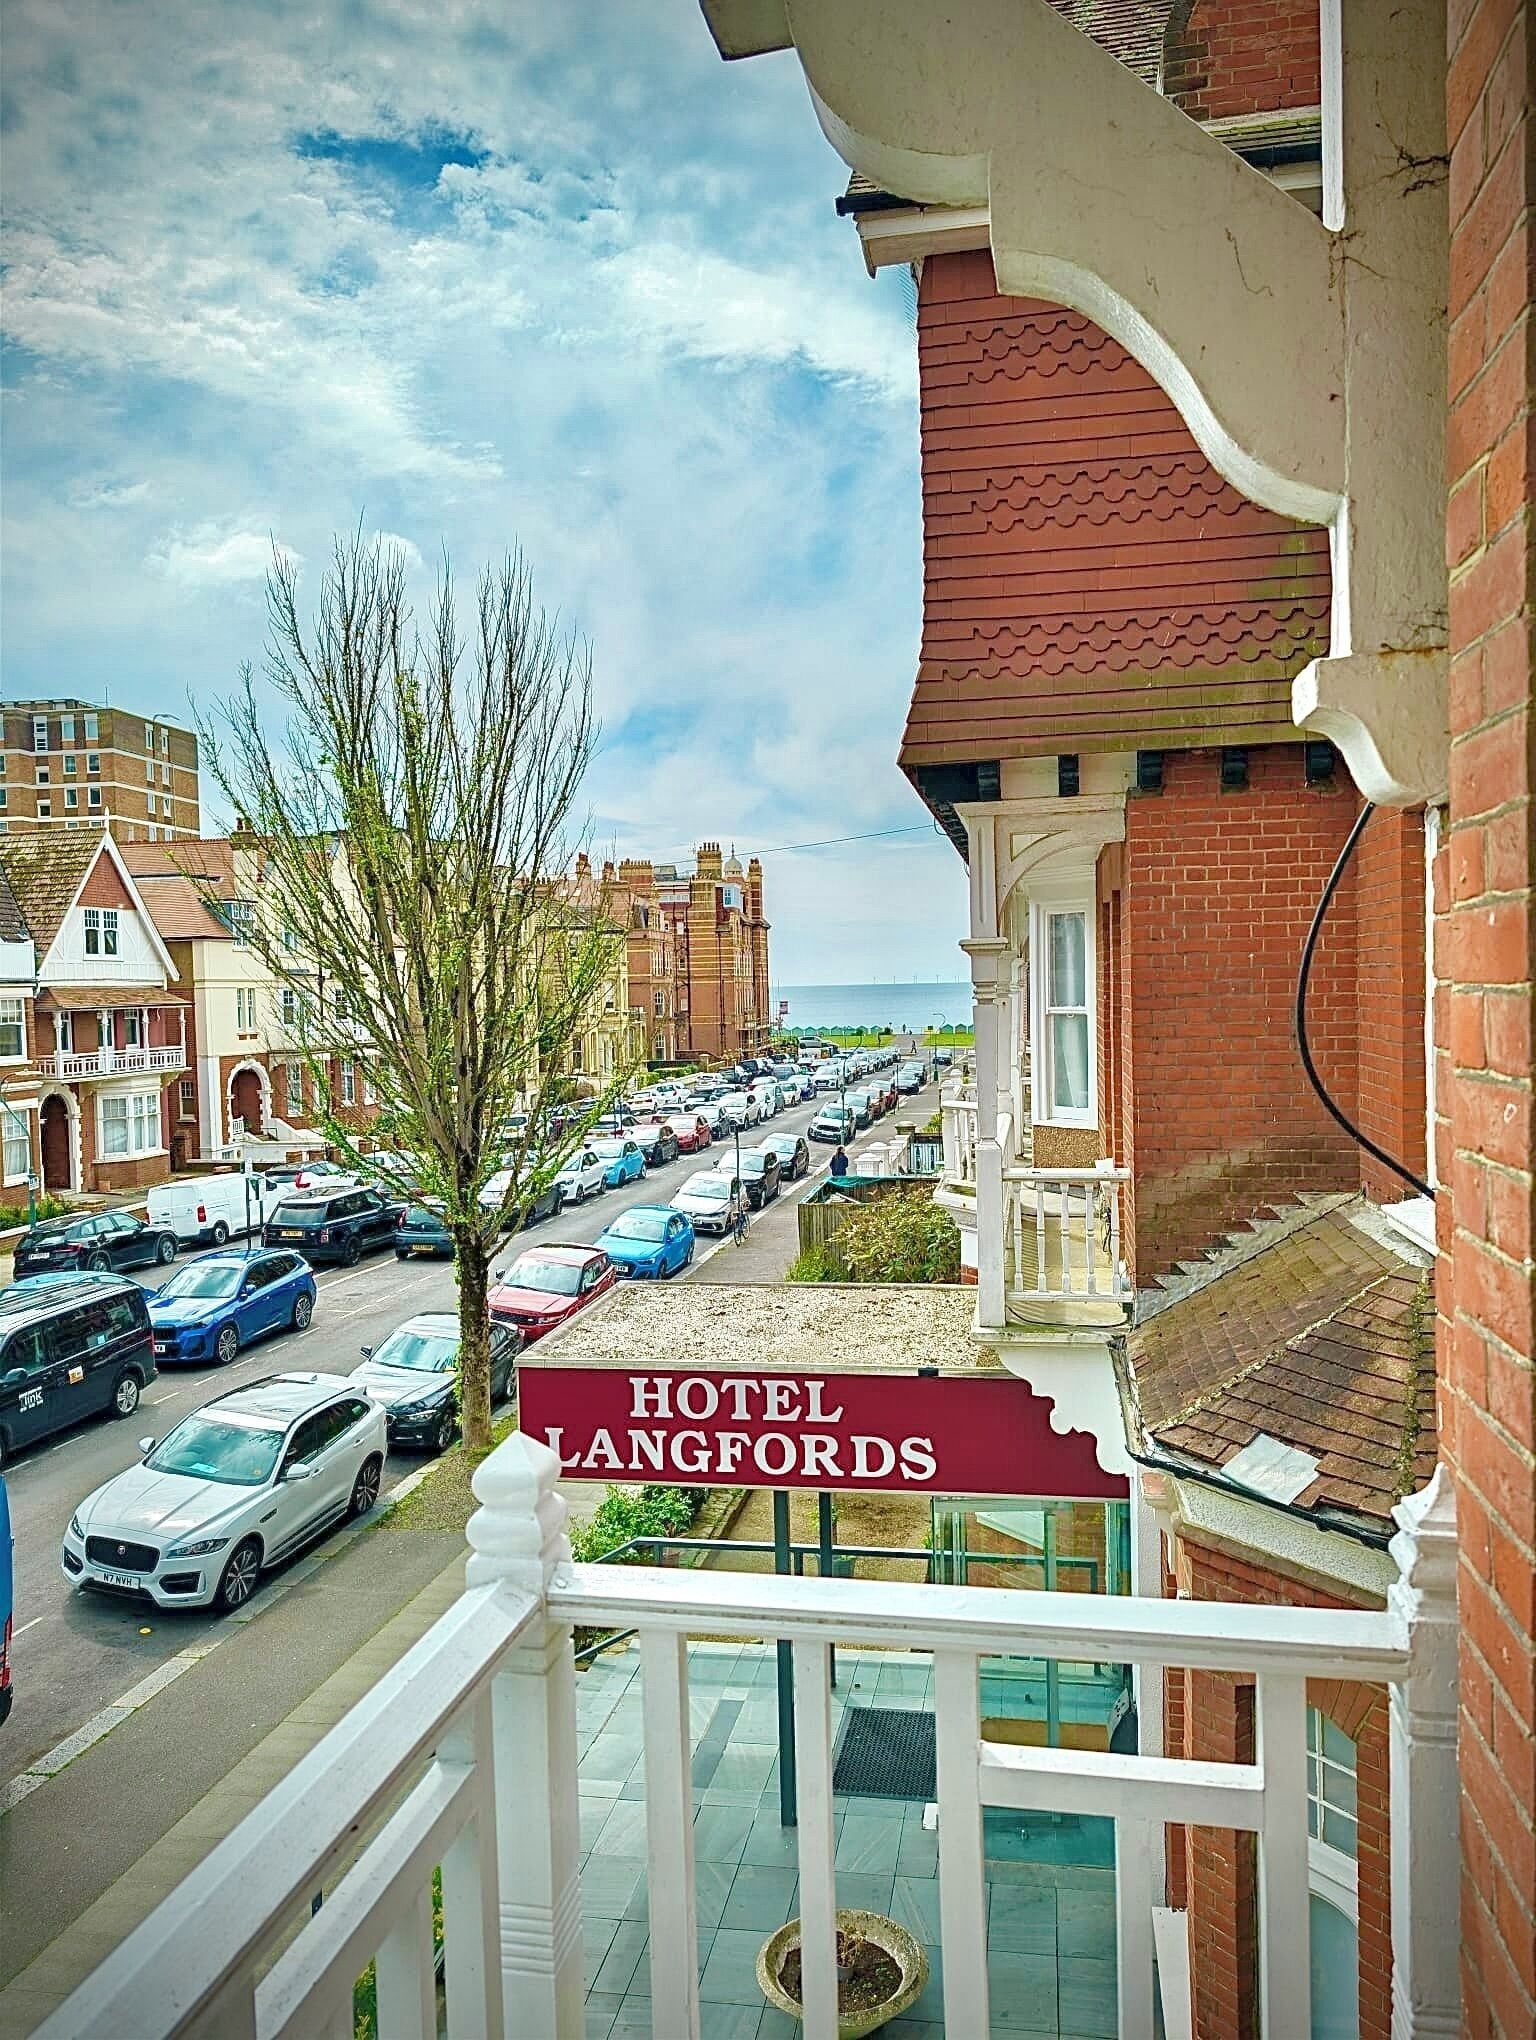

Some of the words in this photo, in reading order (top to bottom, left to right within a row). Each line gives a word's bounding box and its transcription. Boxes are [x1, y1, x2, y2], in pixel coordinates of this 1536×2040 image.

[629, 1376, 844, 1424] HOTEL
[544, 1427, 937, 1481] LANGFORDS
[103, 1572, 114, 1583] N7
[115, 1575, 132, 1587] NVH
